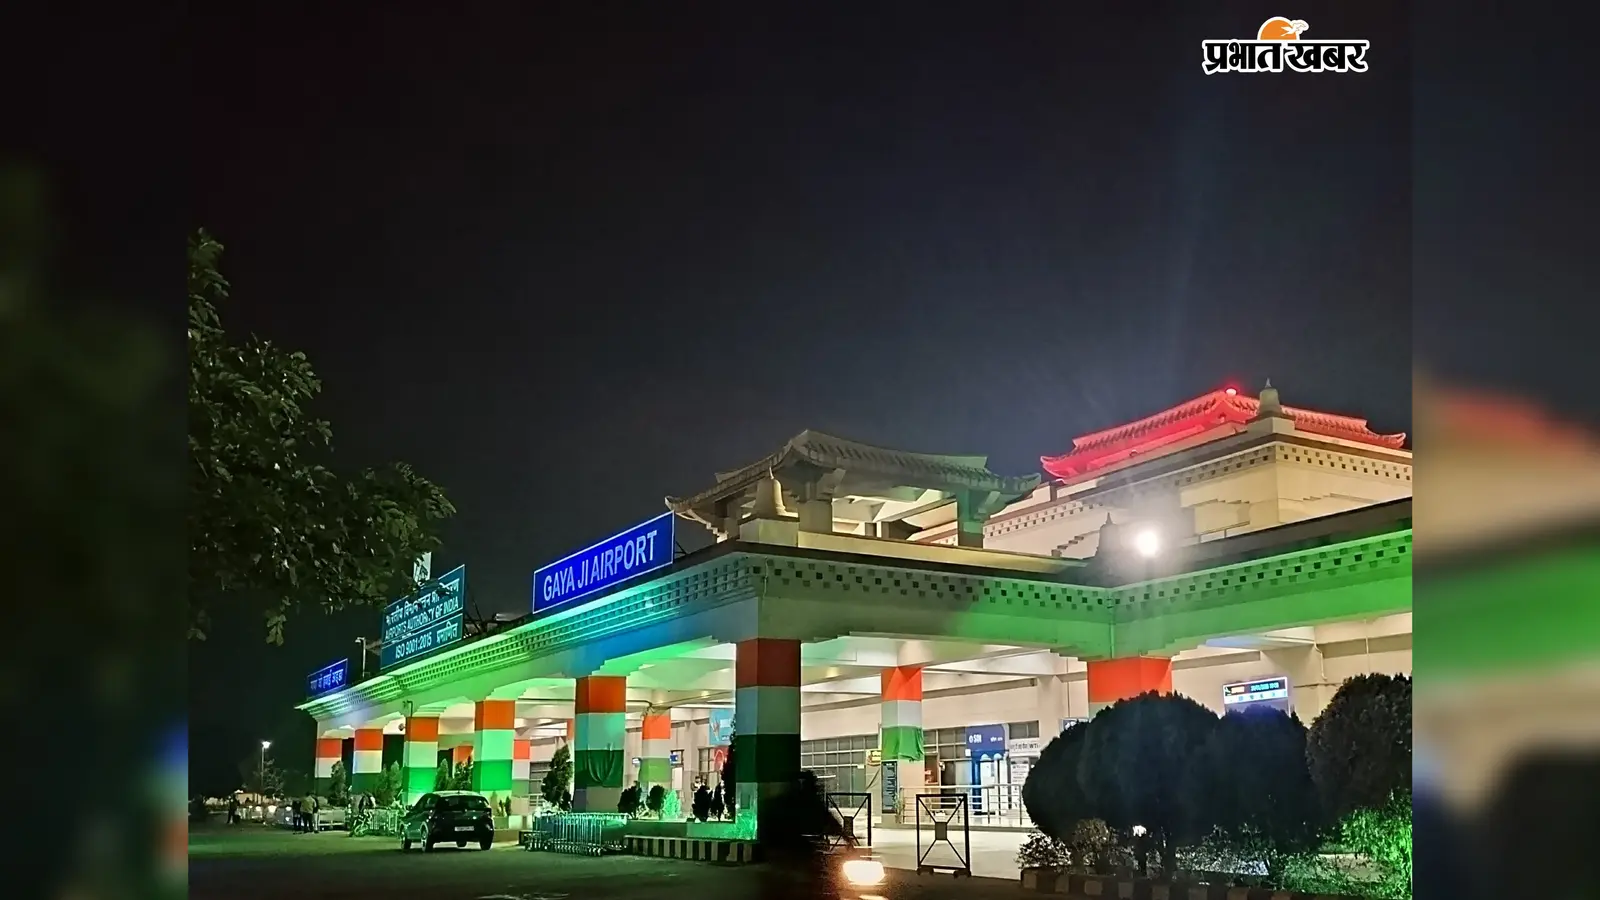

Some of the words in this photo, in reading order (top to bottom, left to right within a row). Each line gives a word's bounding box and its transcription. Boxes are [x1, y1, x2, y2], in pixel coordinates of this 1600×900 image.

[543, 566, 575, 601] GAYA
[577, 559, 589, 589] JI
[590, 530, 657, 584] AIRPORT
[443, 596, 459, 614] INDIA
[395, 643, 405, 659] ISO
[406, 632, 432, 655] 9001:2015
